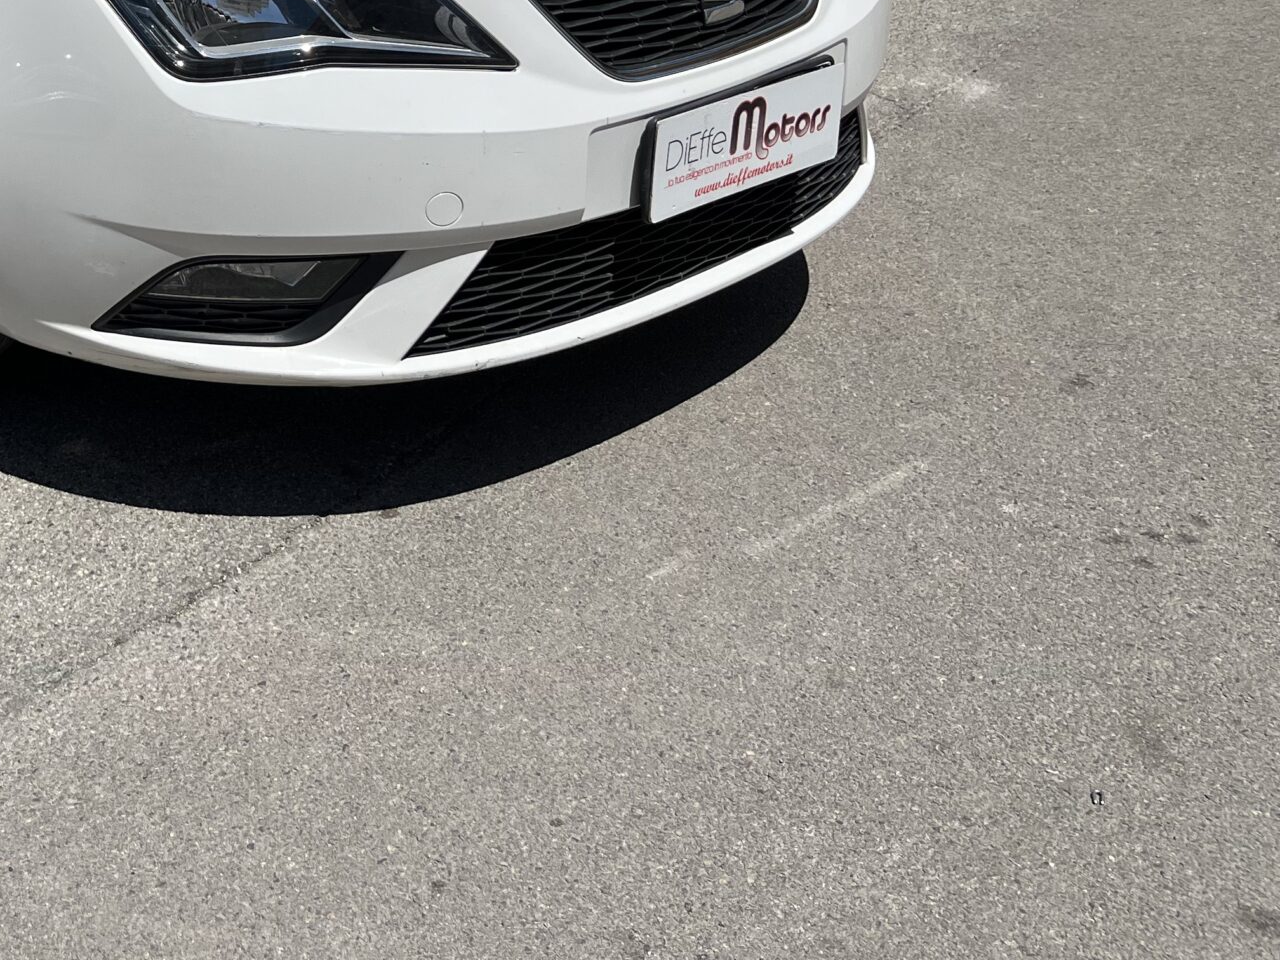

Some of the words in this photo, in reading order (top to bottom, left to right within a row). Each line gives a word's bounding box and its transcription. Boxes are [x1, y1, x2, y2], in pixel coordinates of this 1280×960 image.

[665, 127, 727, 172] DiEffe
[729, 96, 831, 160] Motors
[694, 154, 793, 197] www.dieffemotors.it
